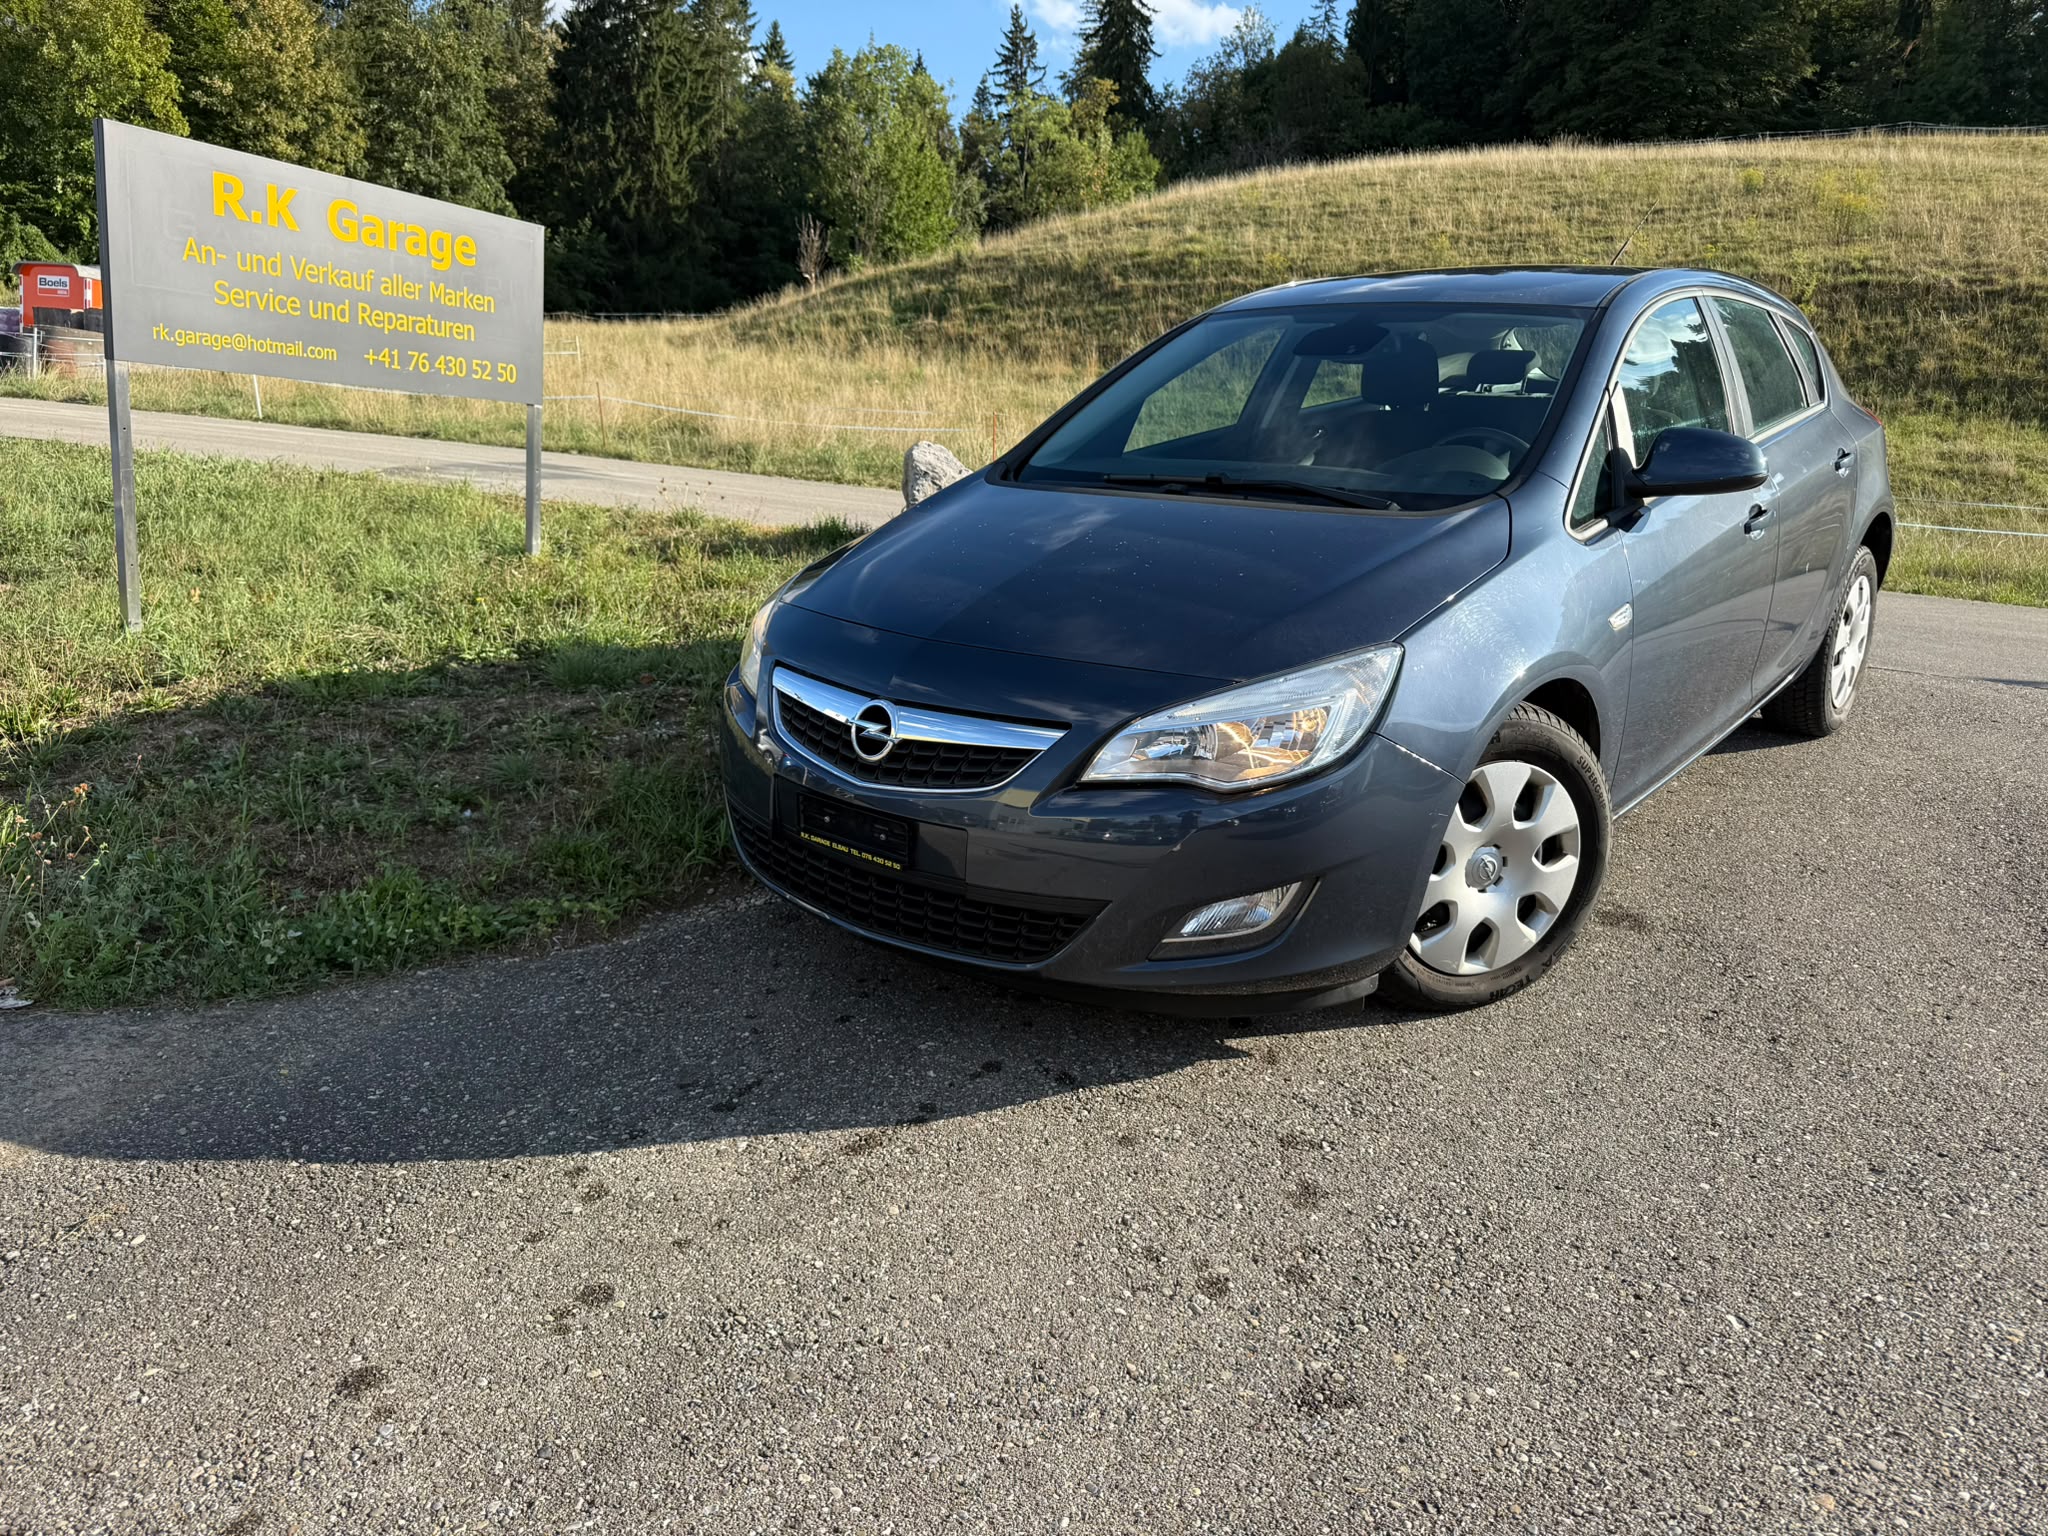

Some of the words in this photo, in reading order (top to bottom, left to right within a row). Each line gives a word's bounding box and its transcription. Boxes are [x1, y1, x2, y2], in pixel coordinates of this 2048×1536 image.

[212, 171, 300, 232] R.K
[327, 199, 477, 271] Garage
[38, 277, 68, 288] Boels
[183, 237, 227, 266] An-
[237, 251, 282, 277] und
[290, 255, 375, 292] Verkauf
[380, 273, 423, 300] aller
[429, 280, 496, 313] Marken
[214, 280, 301, 316] Service
[309, 299, 350, 323] und
[358, 302, 475, 342] Reparaturen
[153, 323, 337, 361] rk.garage@hotmail.com
[364, 347, 401, 370] +41
[407, 350, 430, 374] 76
[434, 354, 467, 378] 430
[472, 359, 492, 381] 52
[497, 363, 517, 384] 50
[1576, 755, 1607, 810] SUPERGRIP
[810, 835, 831, 847] GARAGE
